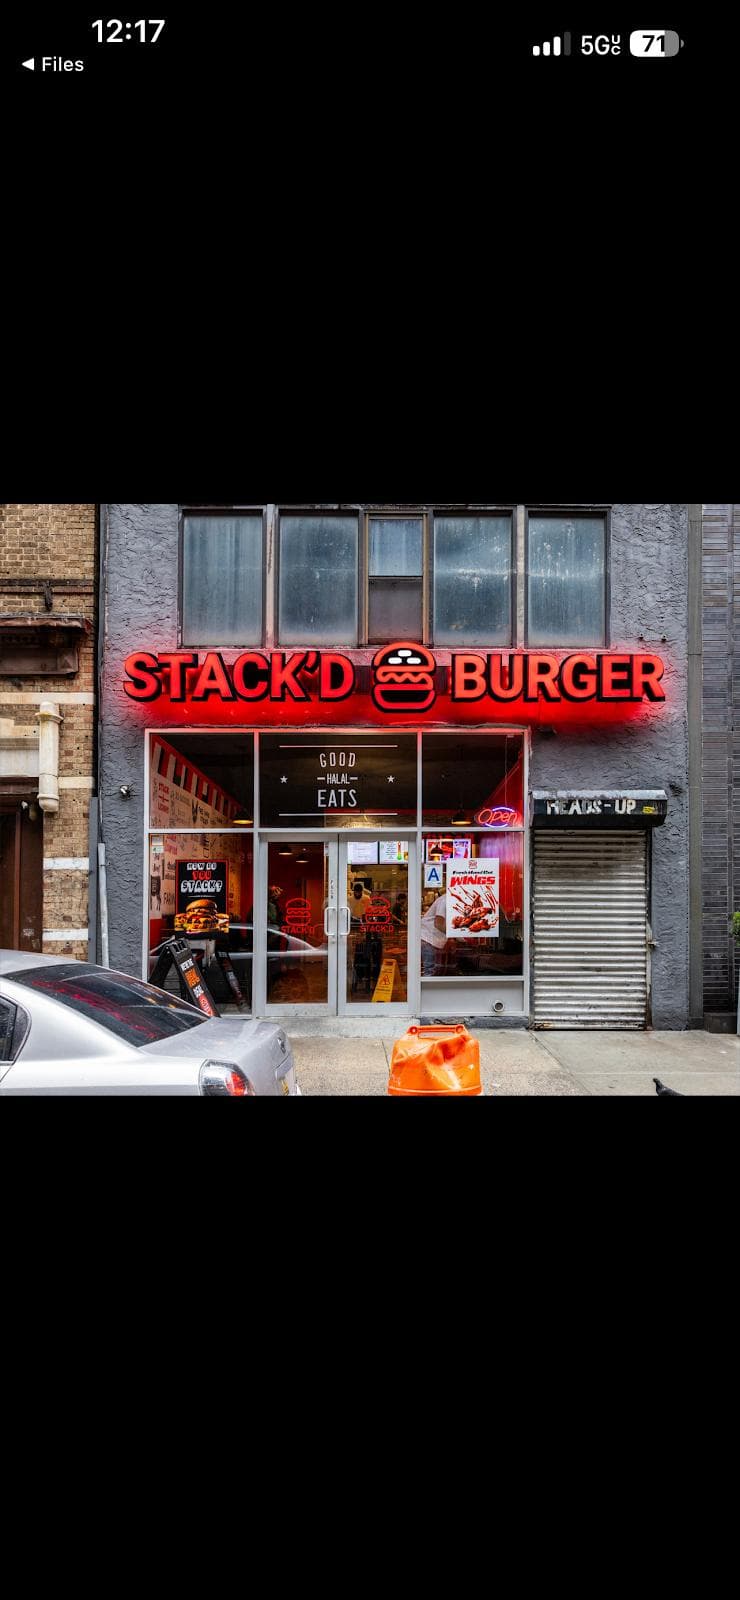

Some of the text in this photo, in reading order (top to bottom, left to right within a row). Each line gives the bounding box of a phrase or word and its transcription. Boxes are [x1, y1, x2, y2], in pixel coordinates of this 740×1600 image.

[123, 650, 666, 704] STACK'D BURGER
[319, 752, 356, 768] GOOD
[326, 773, 351, 785] HALAL
[317, 788, 357, 808] EATS
[478, 808, 518, 827] Open
[192, 870, 212, 880] YOU
[427, 867, 441, 882] A
[450, 875, 496, 887] WINGS
[180, 880, 223, 893] STACK?
